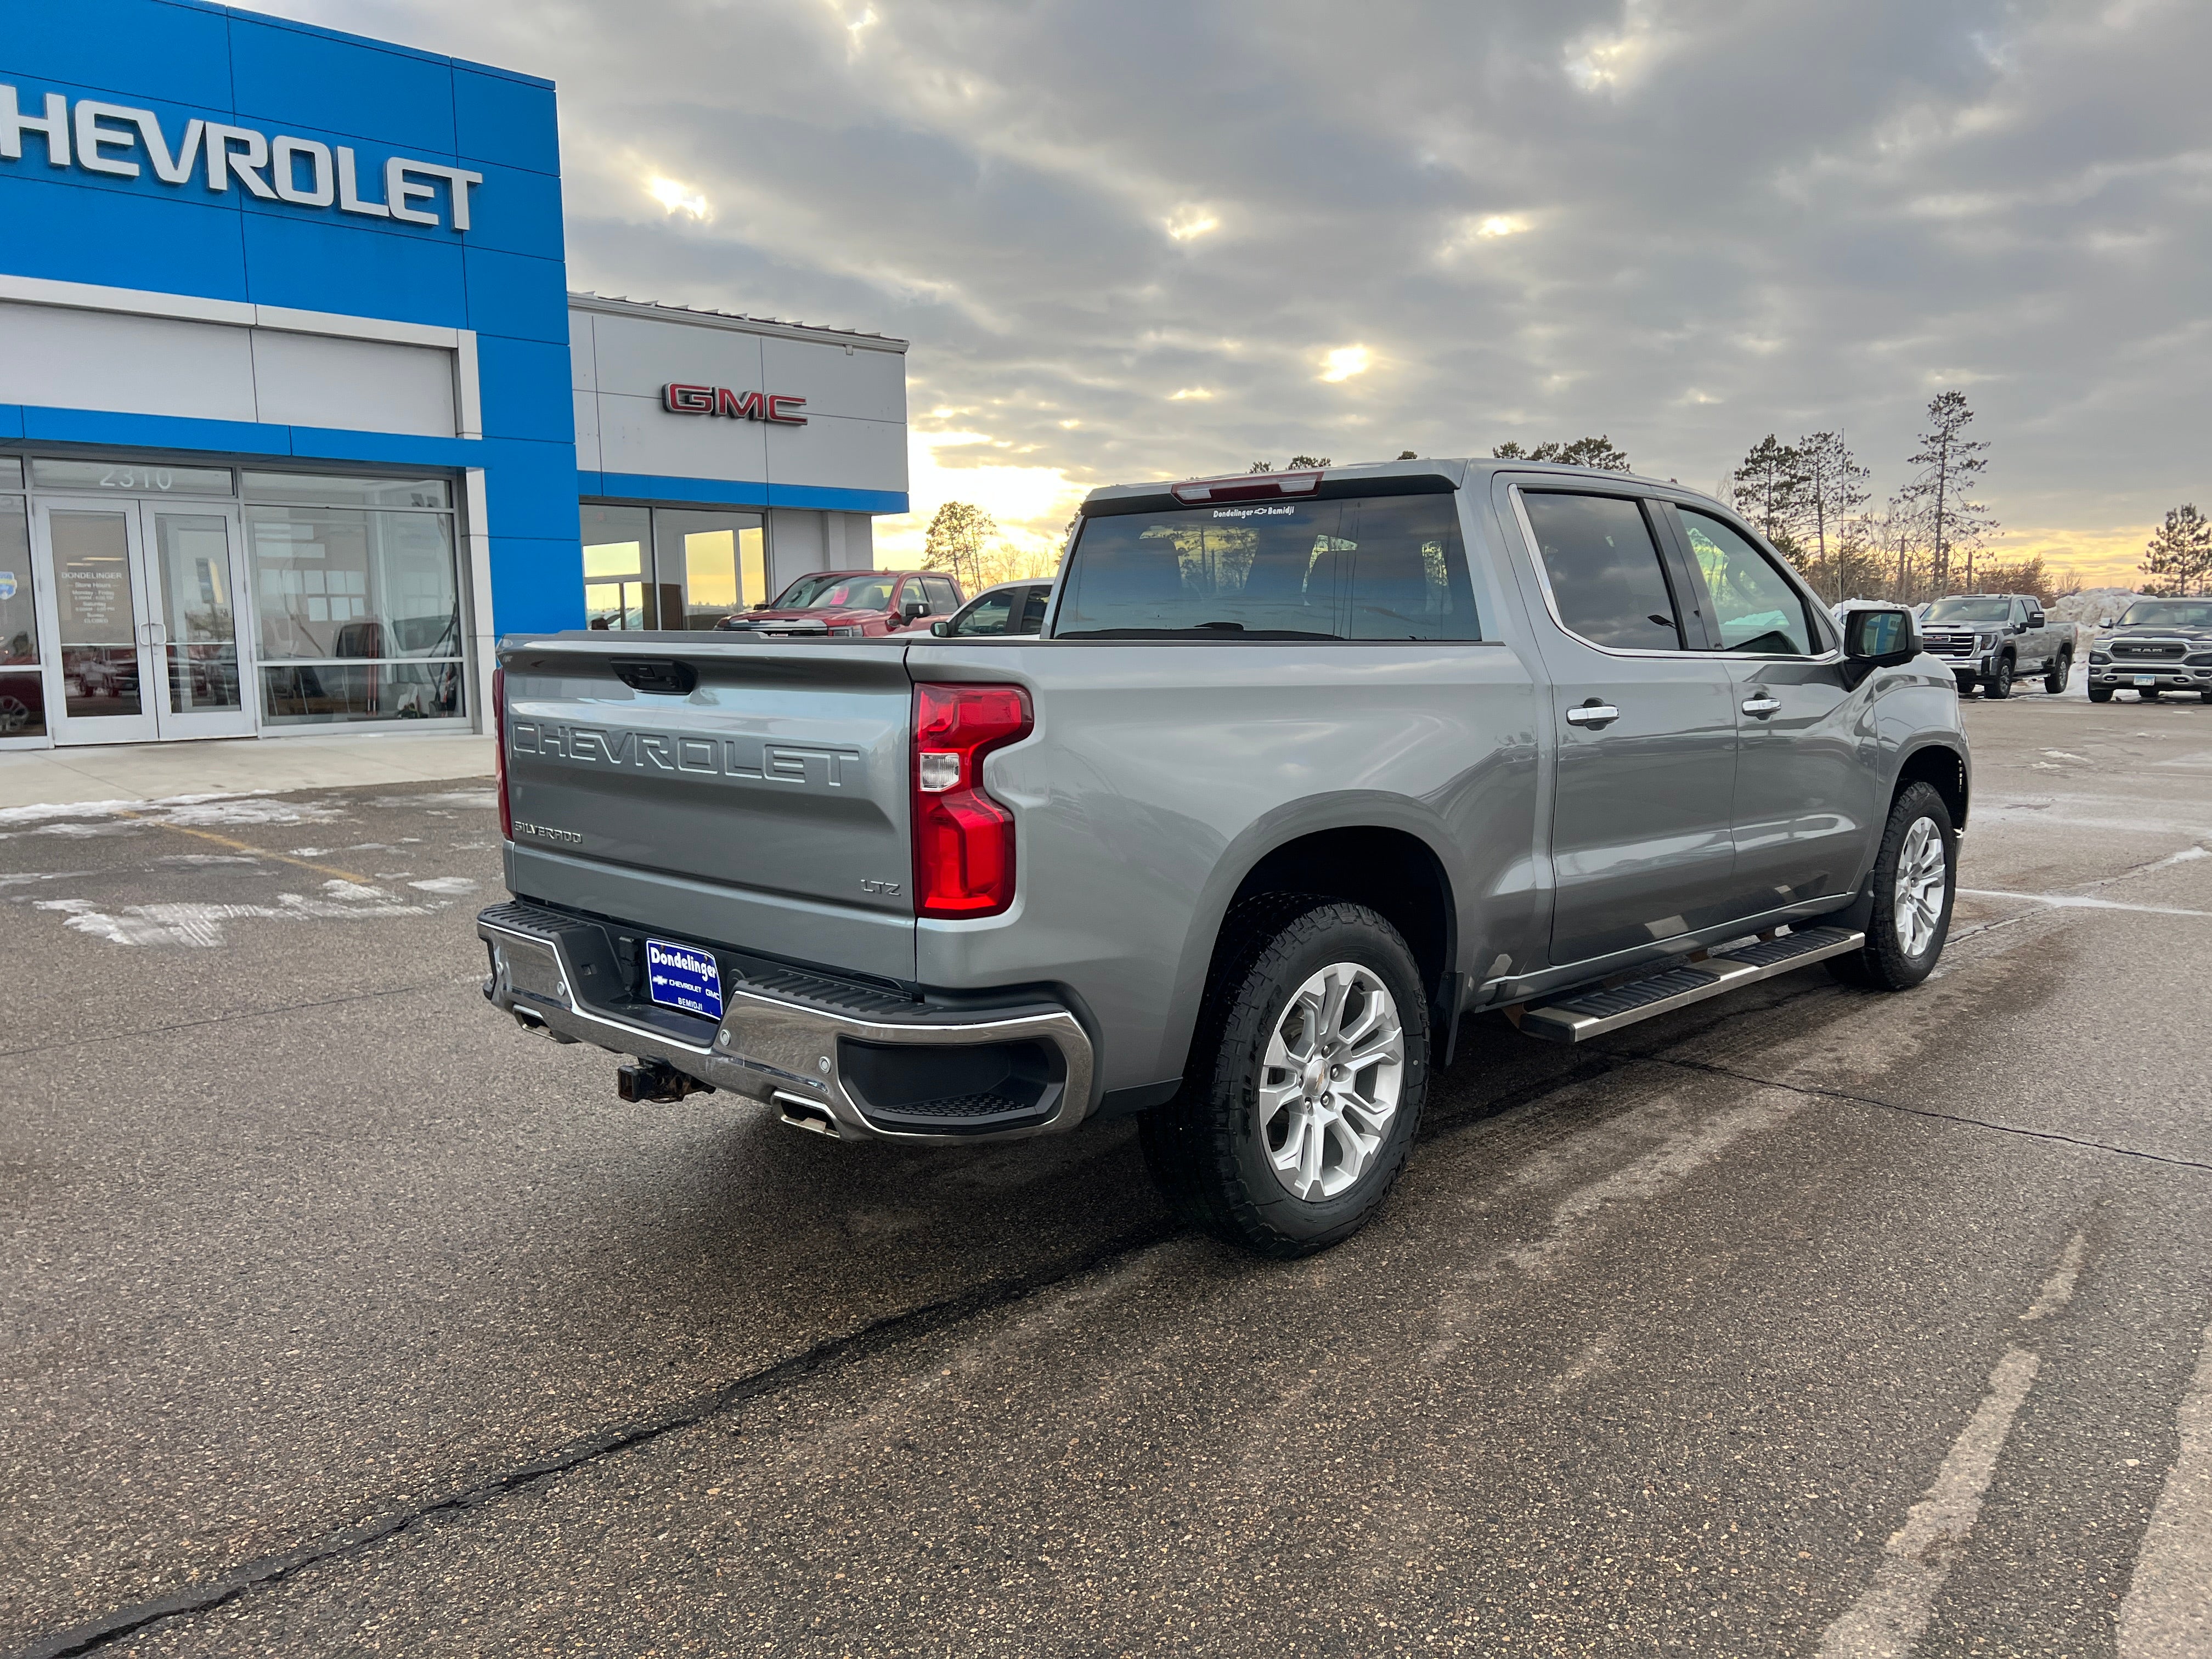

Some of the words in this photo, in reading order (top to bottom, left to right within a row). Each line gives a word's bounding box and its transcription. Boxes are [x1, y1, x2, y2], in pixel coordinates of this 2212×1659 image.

[0, 84, 483, 230] HEVROLET
[662, 382, 808, 425] GMC
[100, 467, 172, 489] 2310
[1213, 510, 1254, 519] Dondelinger
[1267, 506, 1295, 516] Bemidji
[513, 721, 860, 787] CHEVROLET
[515, 821, 582, 843] SILVERADO
[861, 879, 901, 896] LTZ
[650, 946, 716, 982] Dondelinger
[669, 979, 702, 994] CHEVROLET
[705, 988, 720, 1001] GMC
[678, 997, 703, 1011] BEMIDJI
